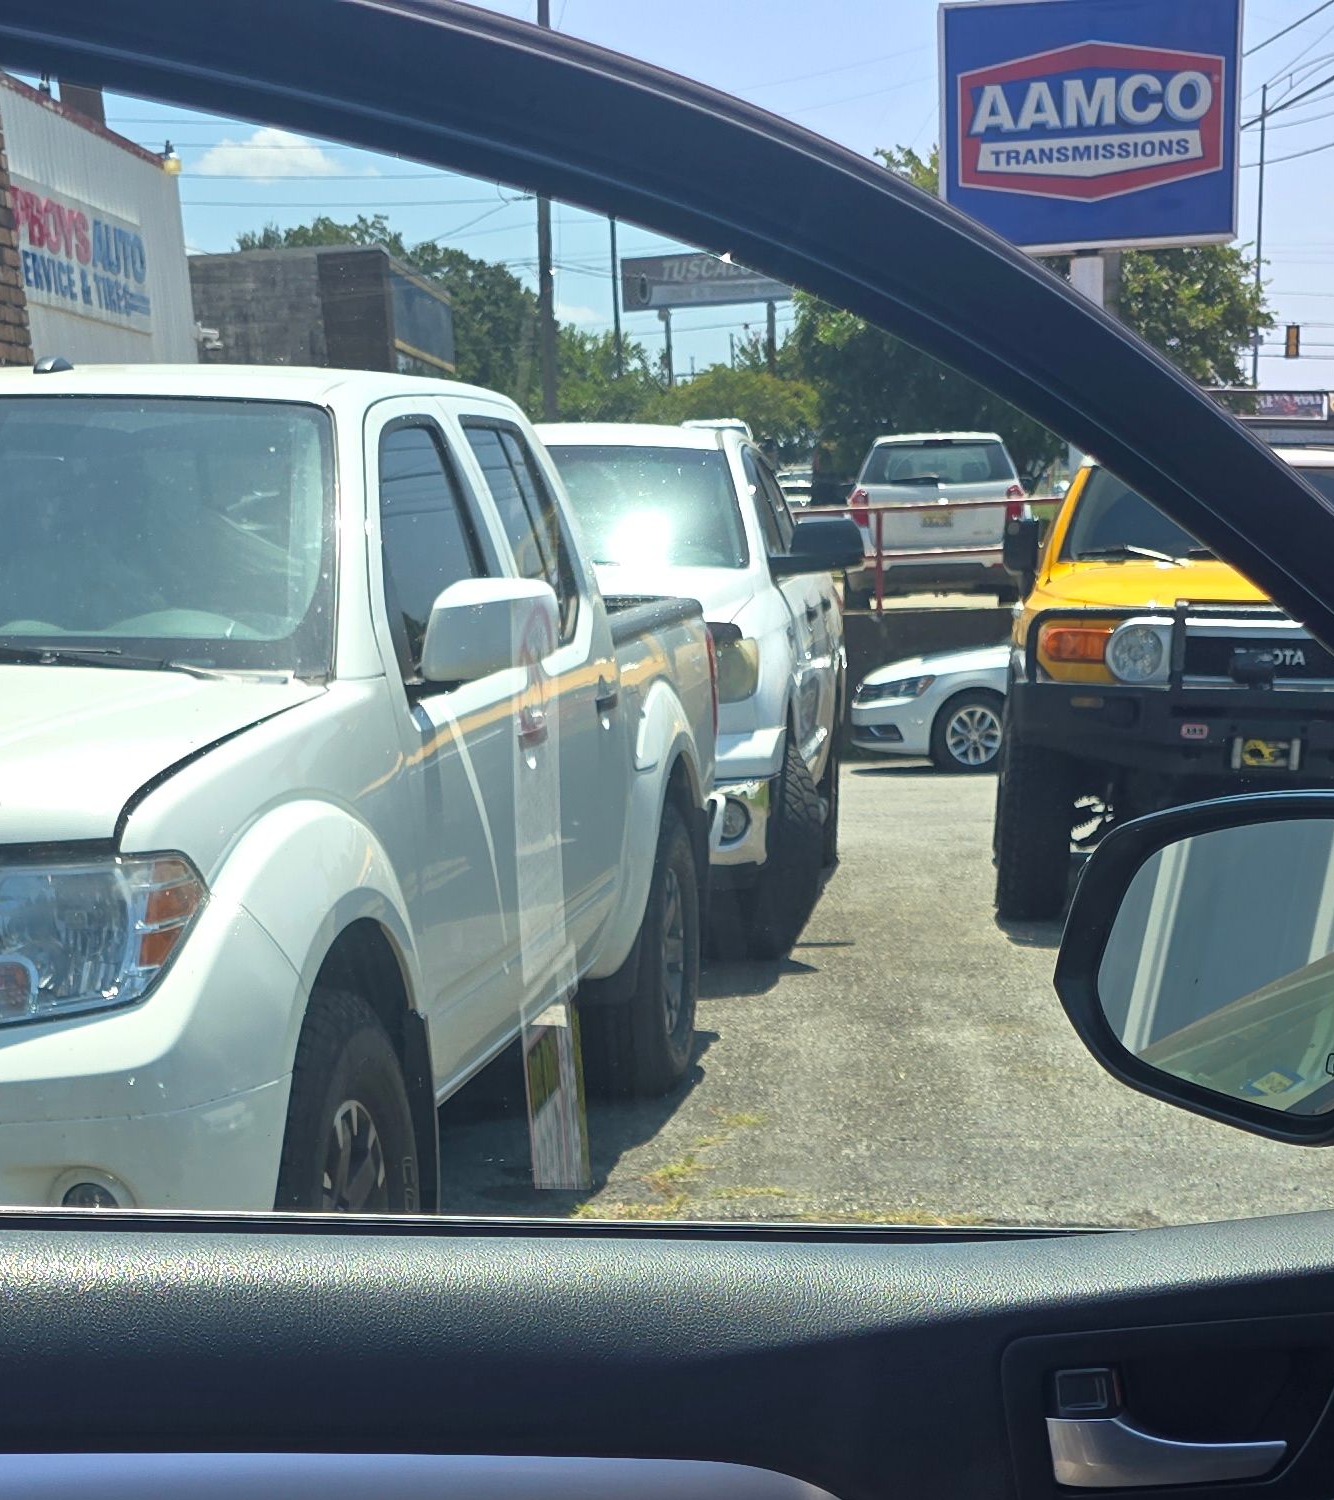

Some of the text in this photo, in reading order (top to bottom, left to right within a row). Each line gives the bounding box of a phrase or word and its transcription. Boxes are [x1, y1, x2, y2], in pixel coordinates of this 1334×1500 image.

[970, 70, 1214, 135] AAMCO
[990, 138, 1191, 168] TRANSMISSIONS
[22, 250, 79, 301] ERVICE
[80, 268, 93, 306] &
[92, 219, 147, 284] AUTO
